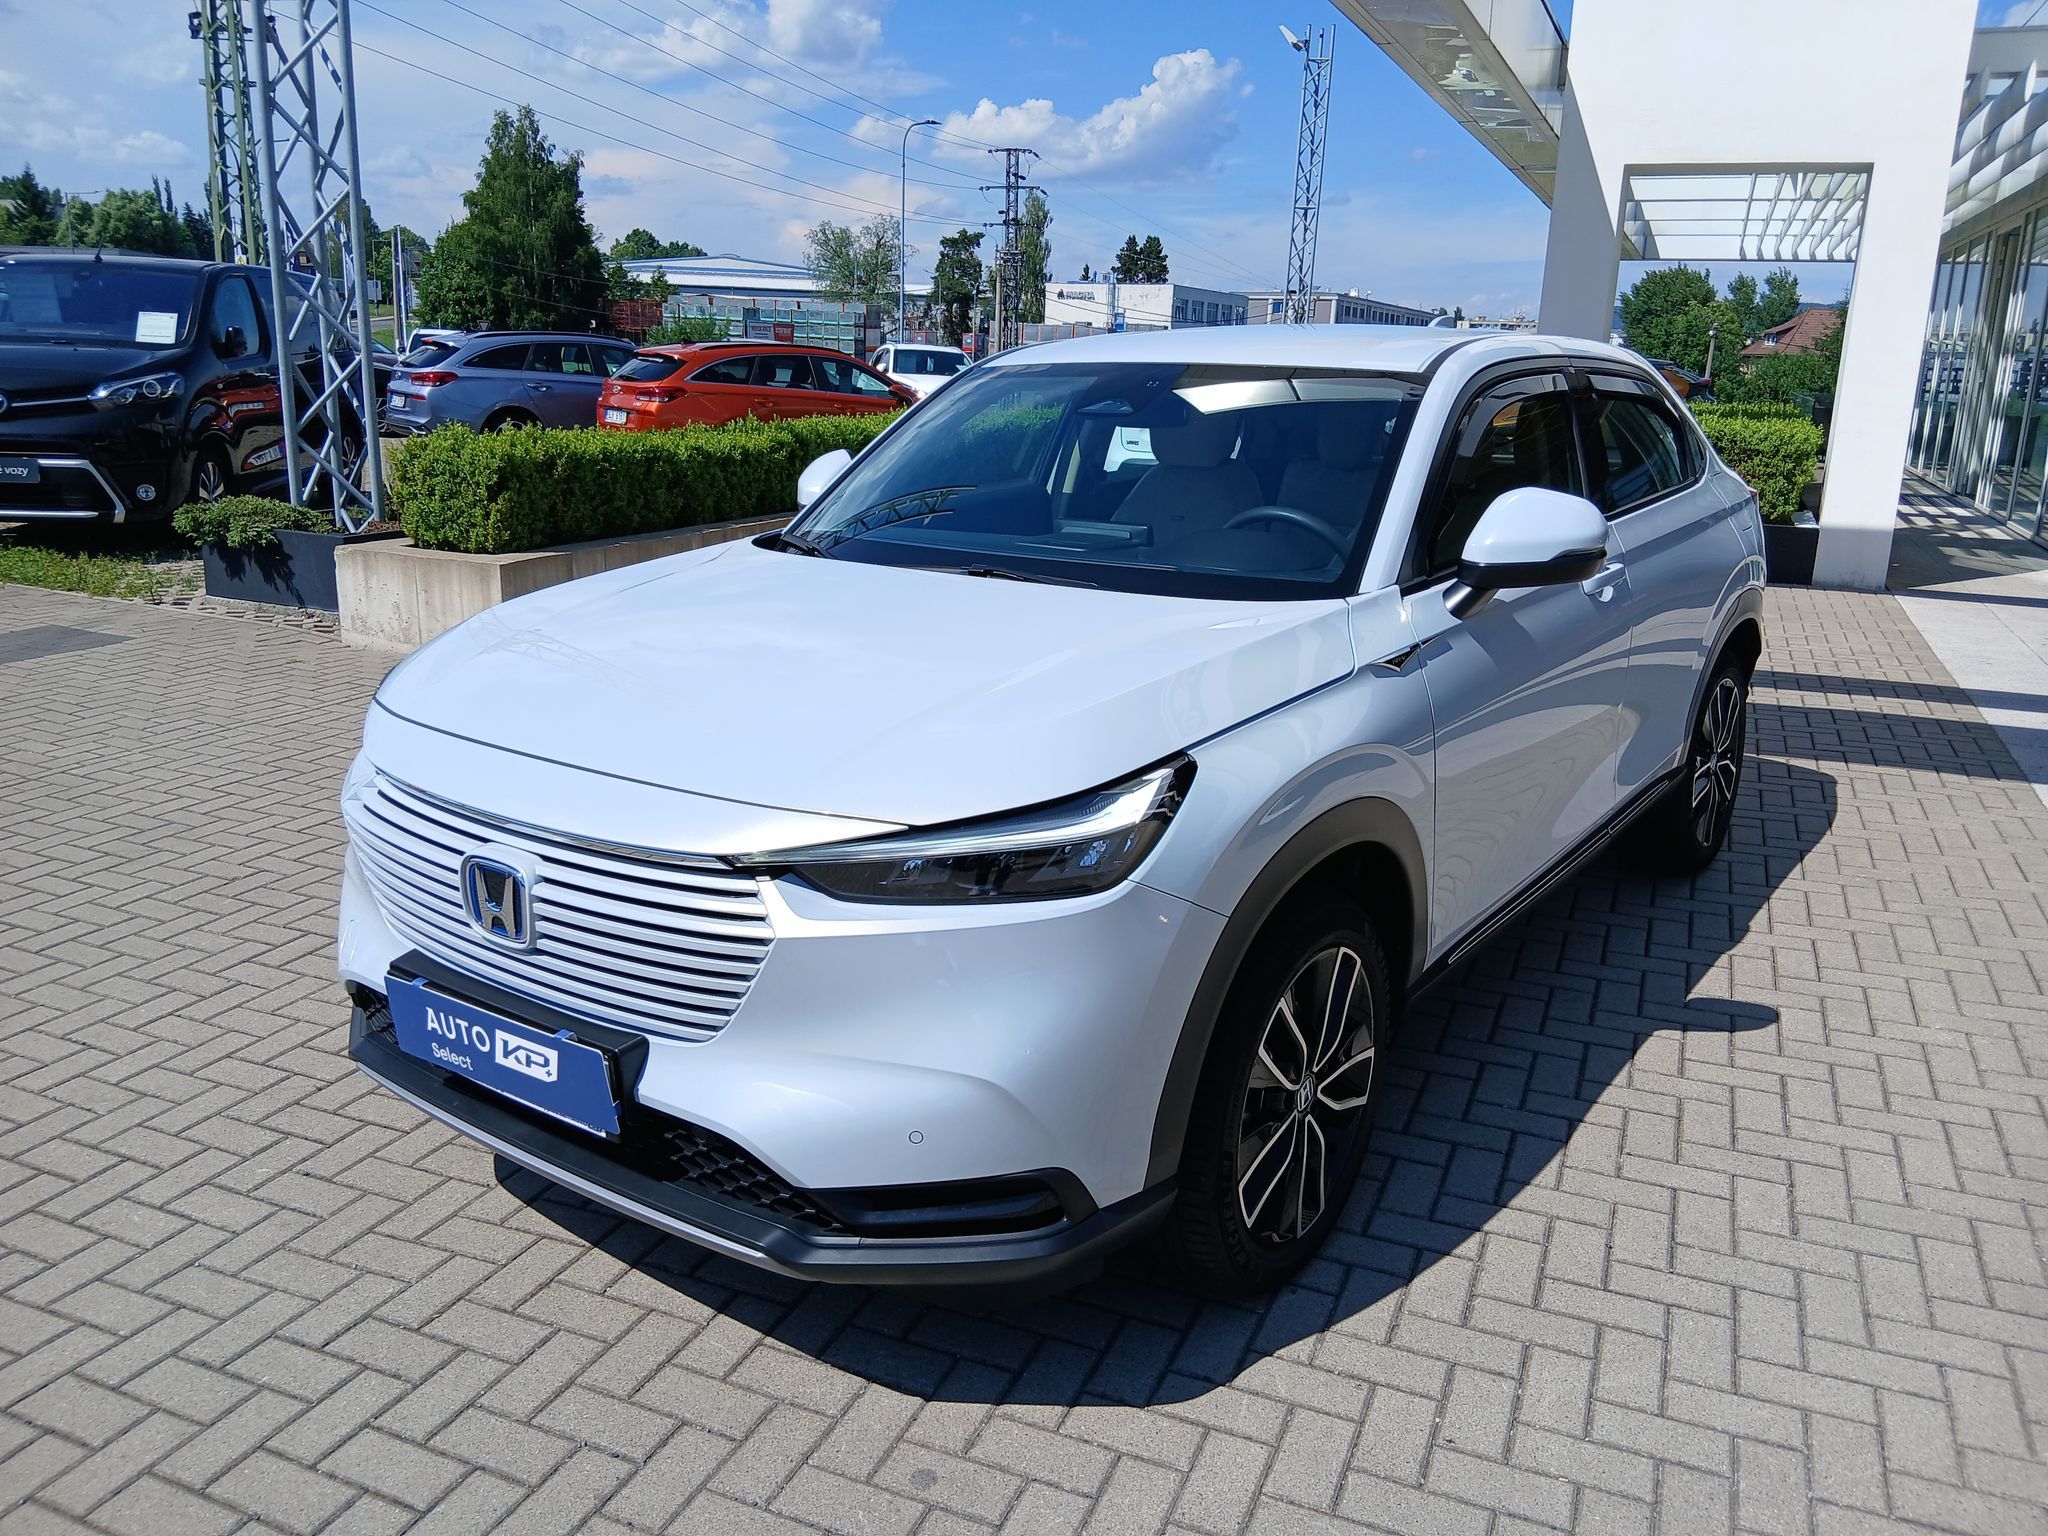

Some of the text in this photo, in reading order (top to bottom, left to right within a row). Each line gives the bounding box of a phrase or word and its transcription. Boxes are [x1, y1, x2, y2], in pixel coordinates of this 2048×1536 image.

[4, 467, 29, 477] vozy
[425, 1006, 491, 1053] AUTO
[431, 1042, 474, 1072] Select
